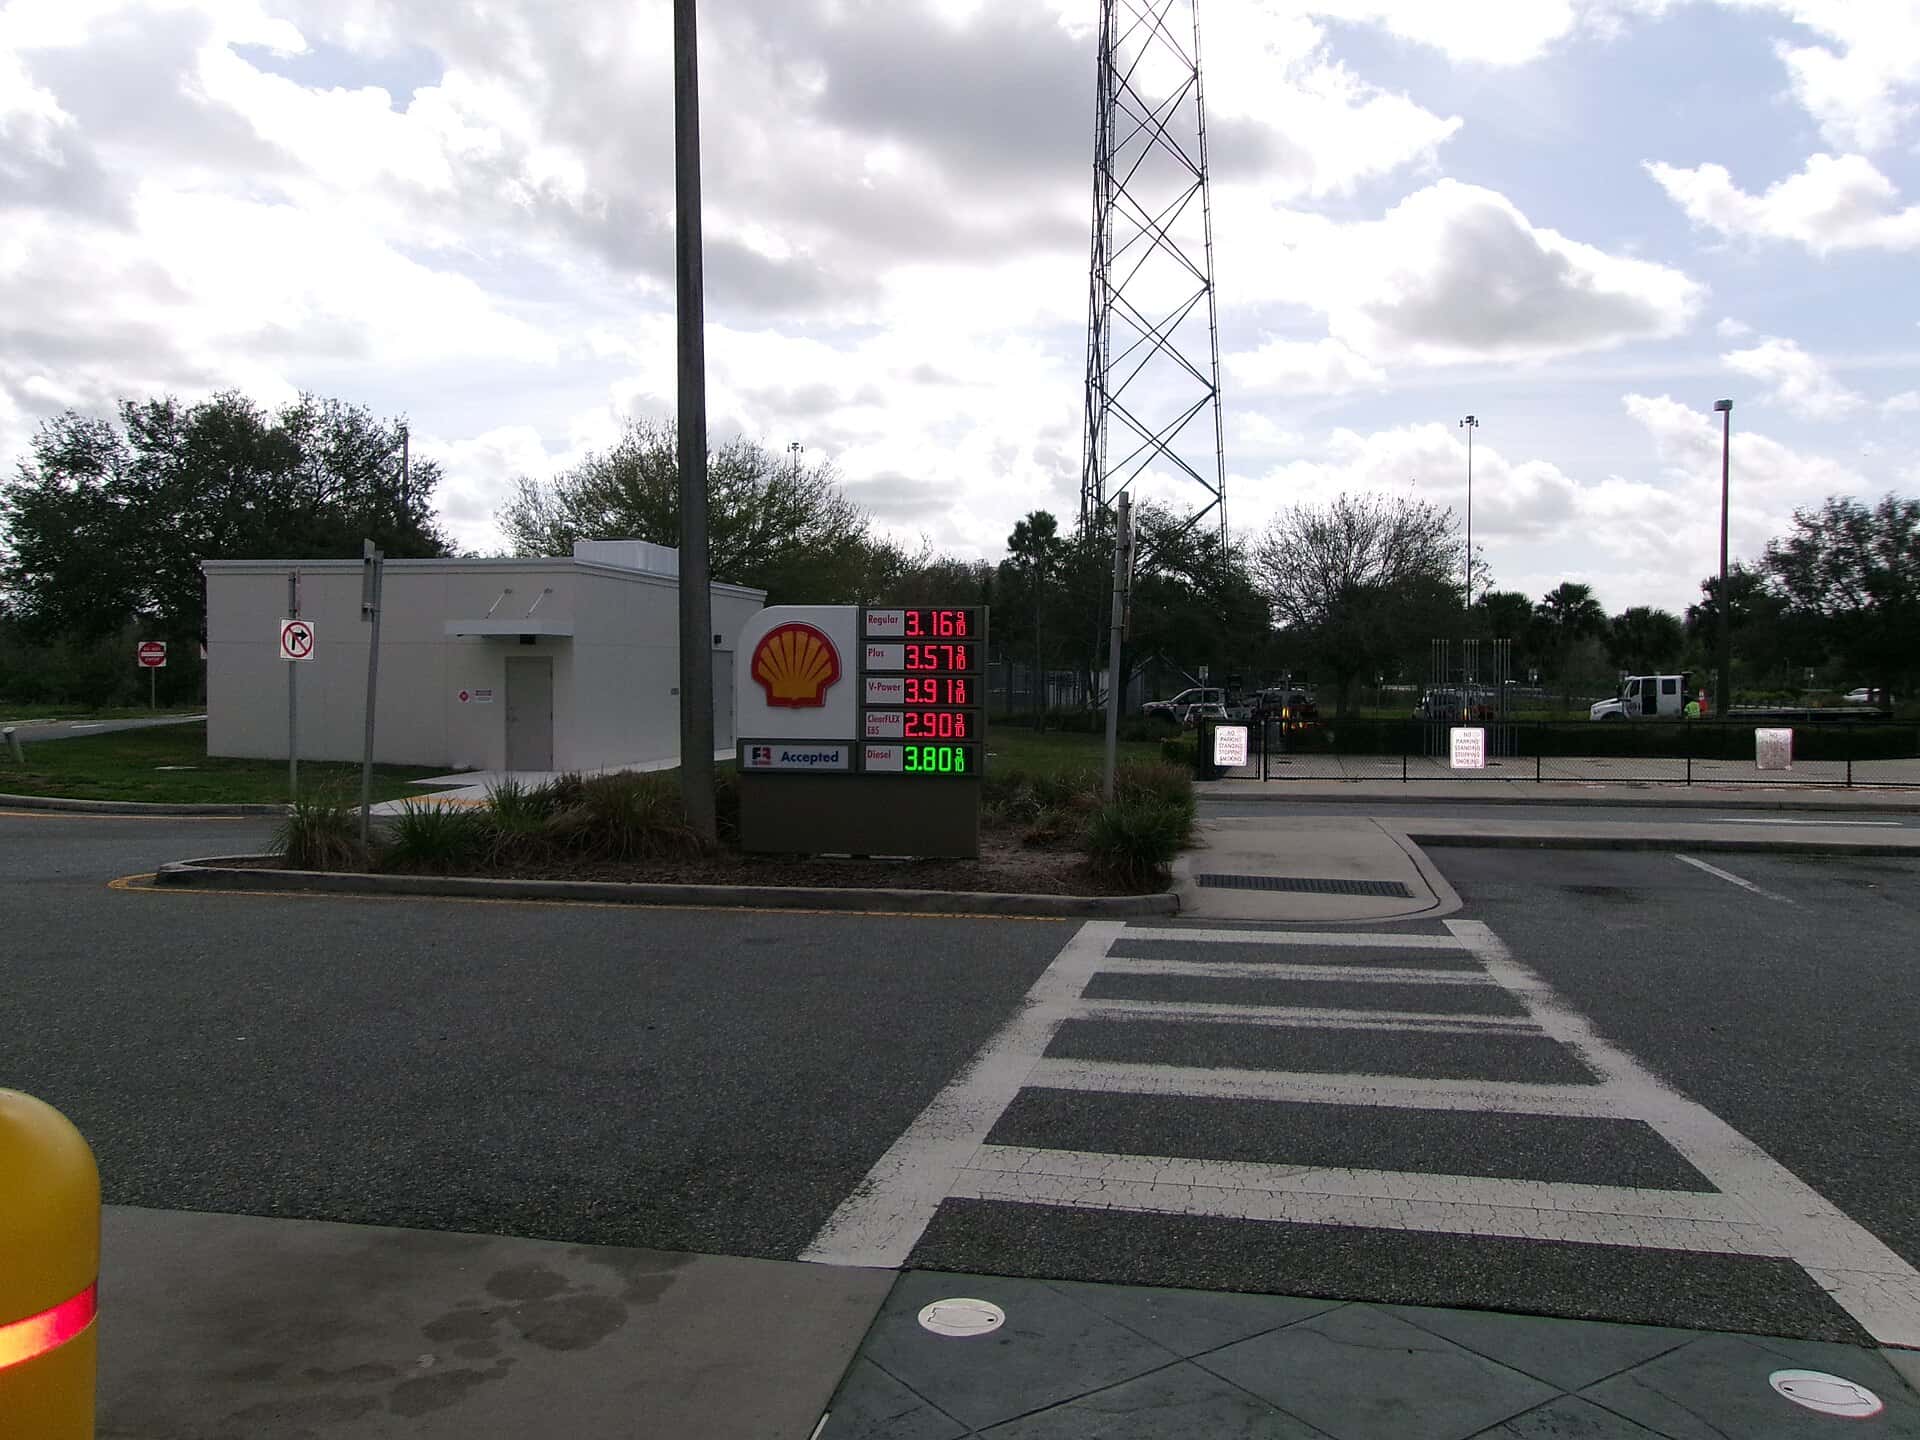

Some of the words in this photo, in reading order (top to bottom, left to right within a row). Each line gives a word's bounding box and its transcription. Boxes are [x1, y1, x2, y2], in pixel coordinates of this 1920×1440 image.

[868, 615, 898, 625] Regular
[906, 611, 953, 636] 3.16
[868, 648, 884, 657] Plus
[906, 645, 953, 670] 3.57
[868, 682, 901, 692] V-Power
[905, 679, 952, 703] 3.91
[905, 712, 952, 737] 2.90
[781, 751, 839, 765] Accepted
[867, 750, 891, 759] Diesel
[905, 746, 952, 771] 3.80
